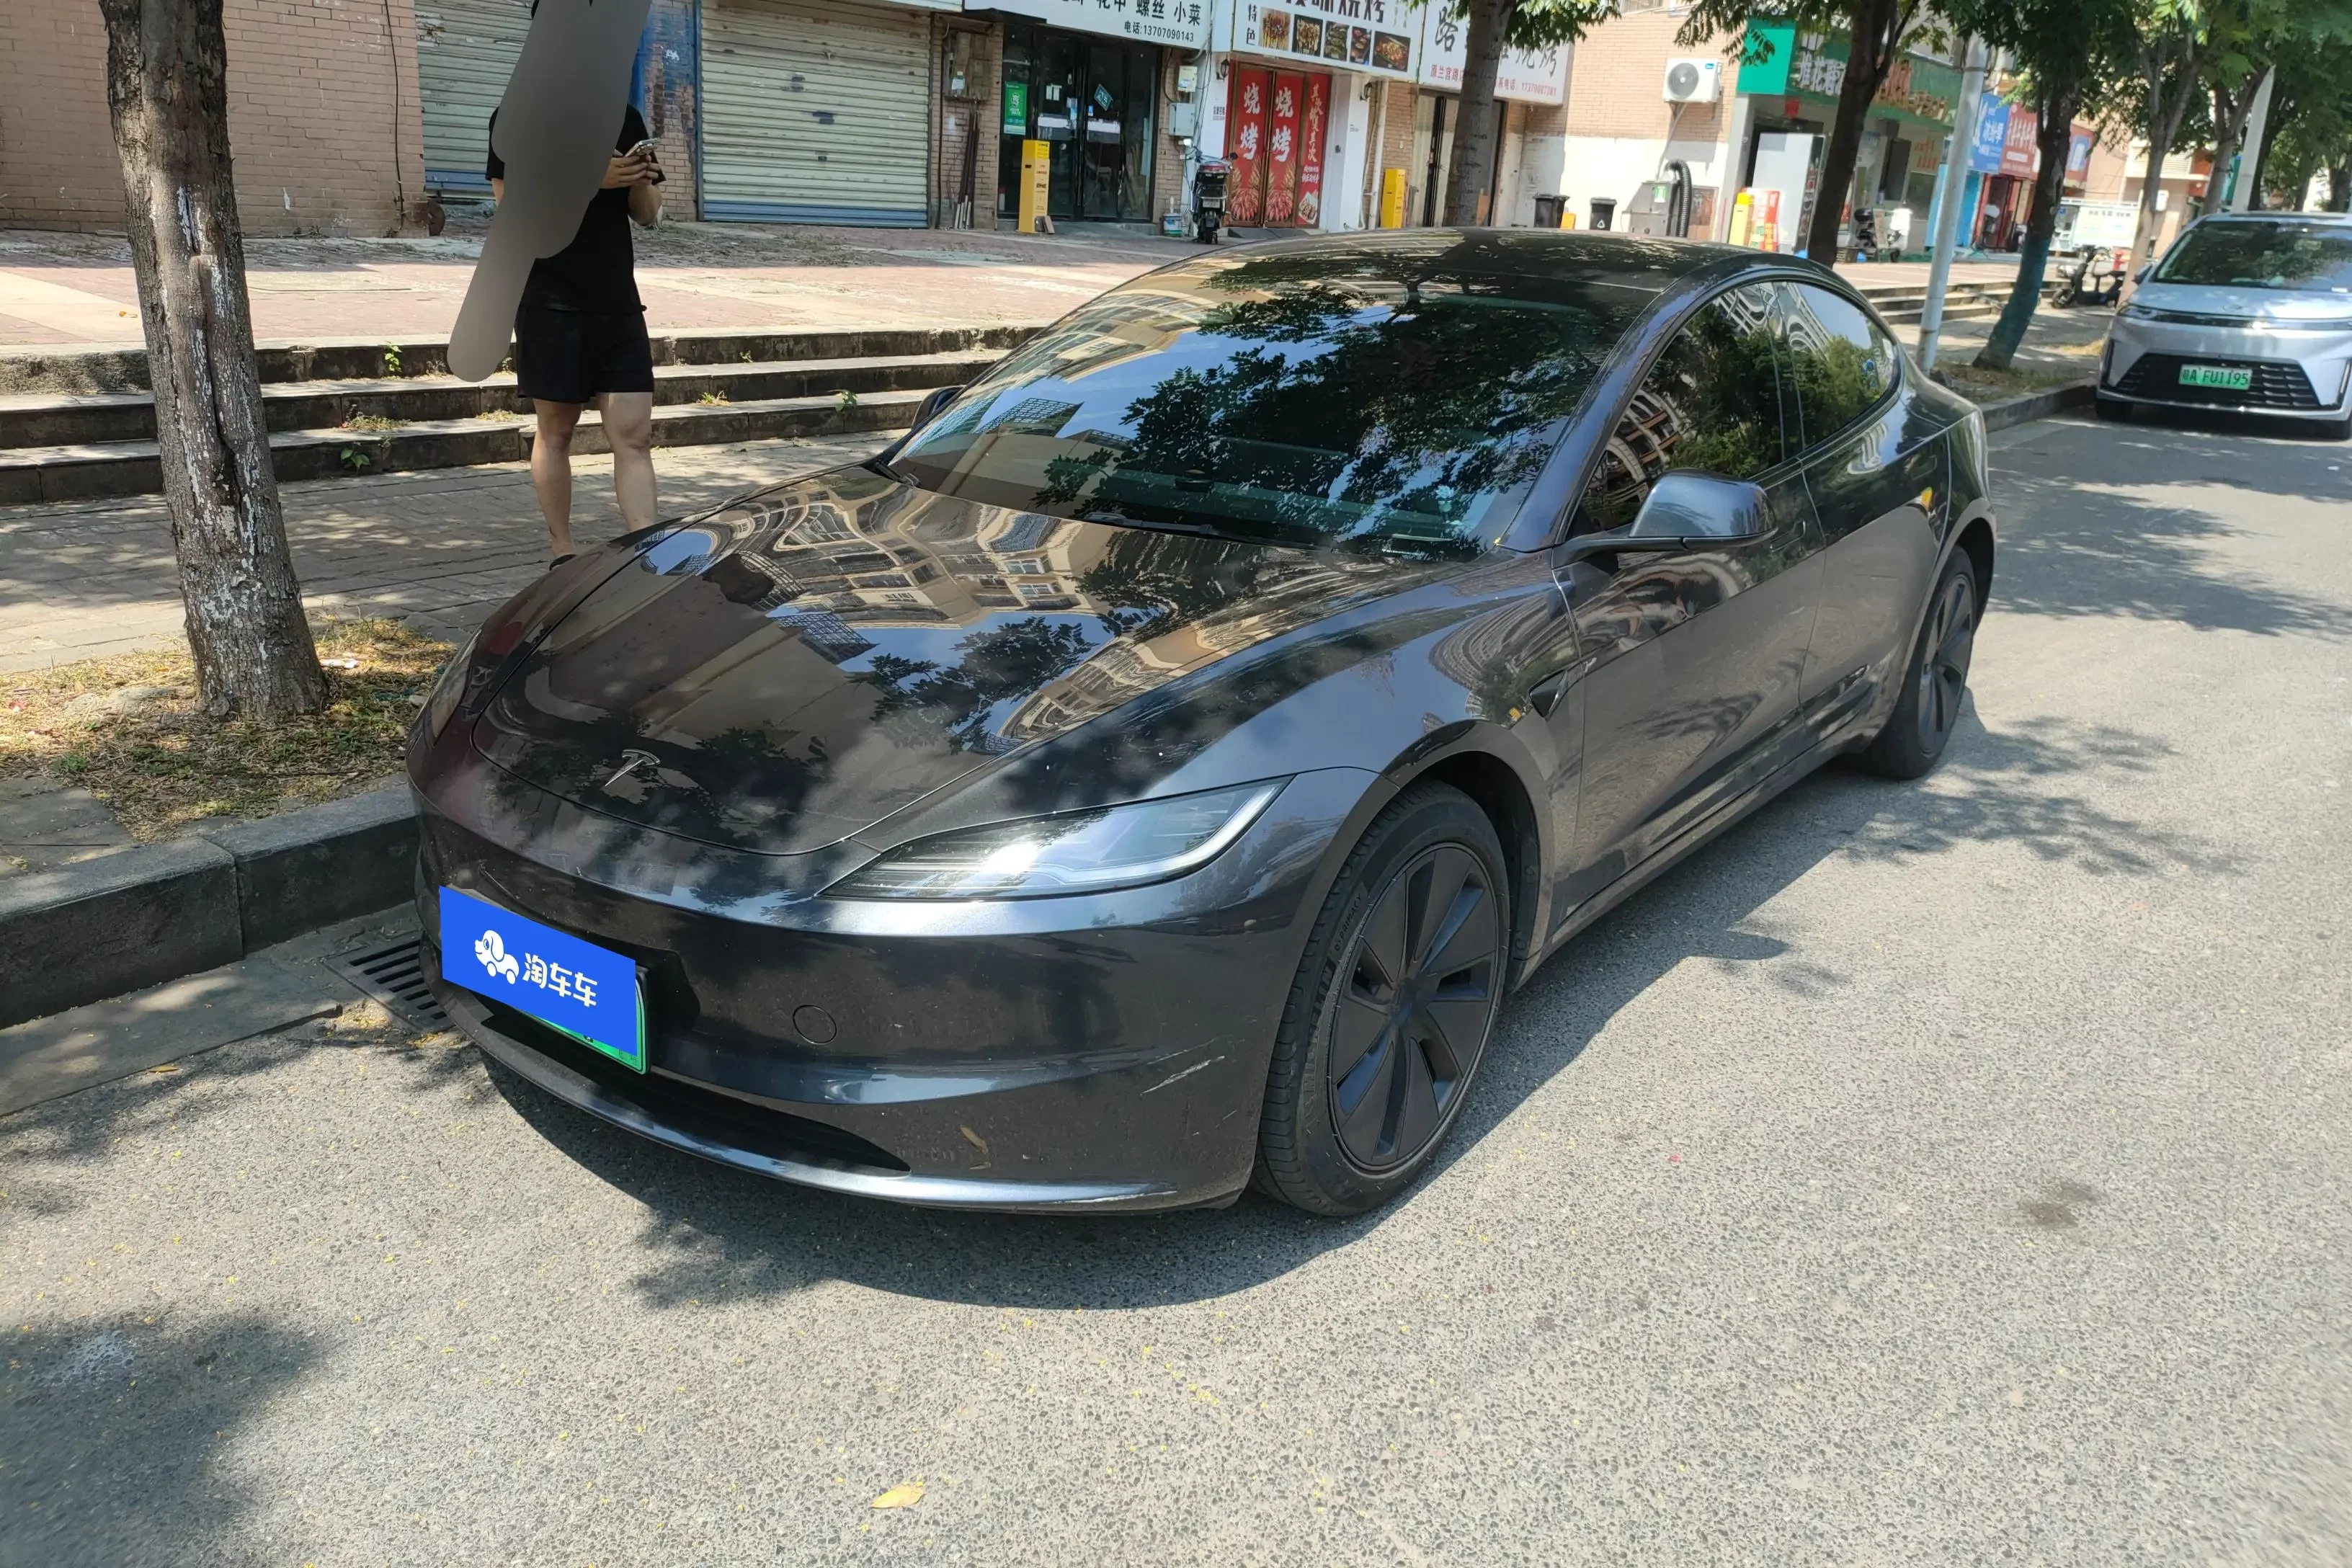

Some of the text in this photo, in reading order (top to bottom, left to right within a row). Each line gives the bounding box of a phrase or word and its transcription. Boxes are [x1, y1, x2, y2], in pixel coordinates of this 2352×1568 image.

[1136, 0, 1164, 19] 螺丝
[1174, 1, 1201, 26] 小菜
[1246, 4, 1257, 45] 特色
[1240, 82, 1260, 160] 烧烤
[1273, 86, 1293, 162] 烧烤
